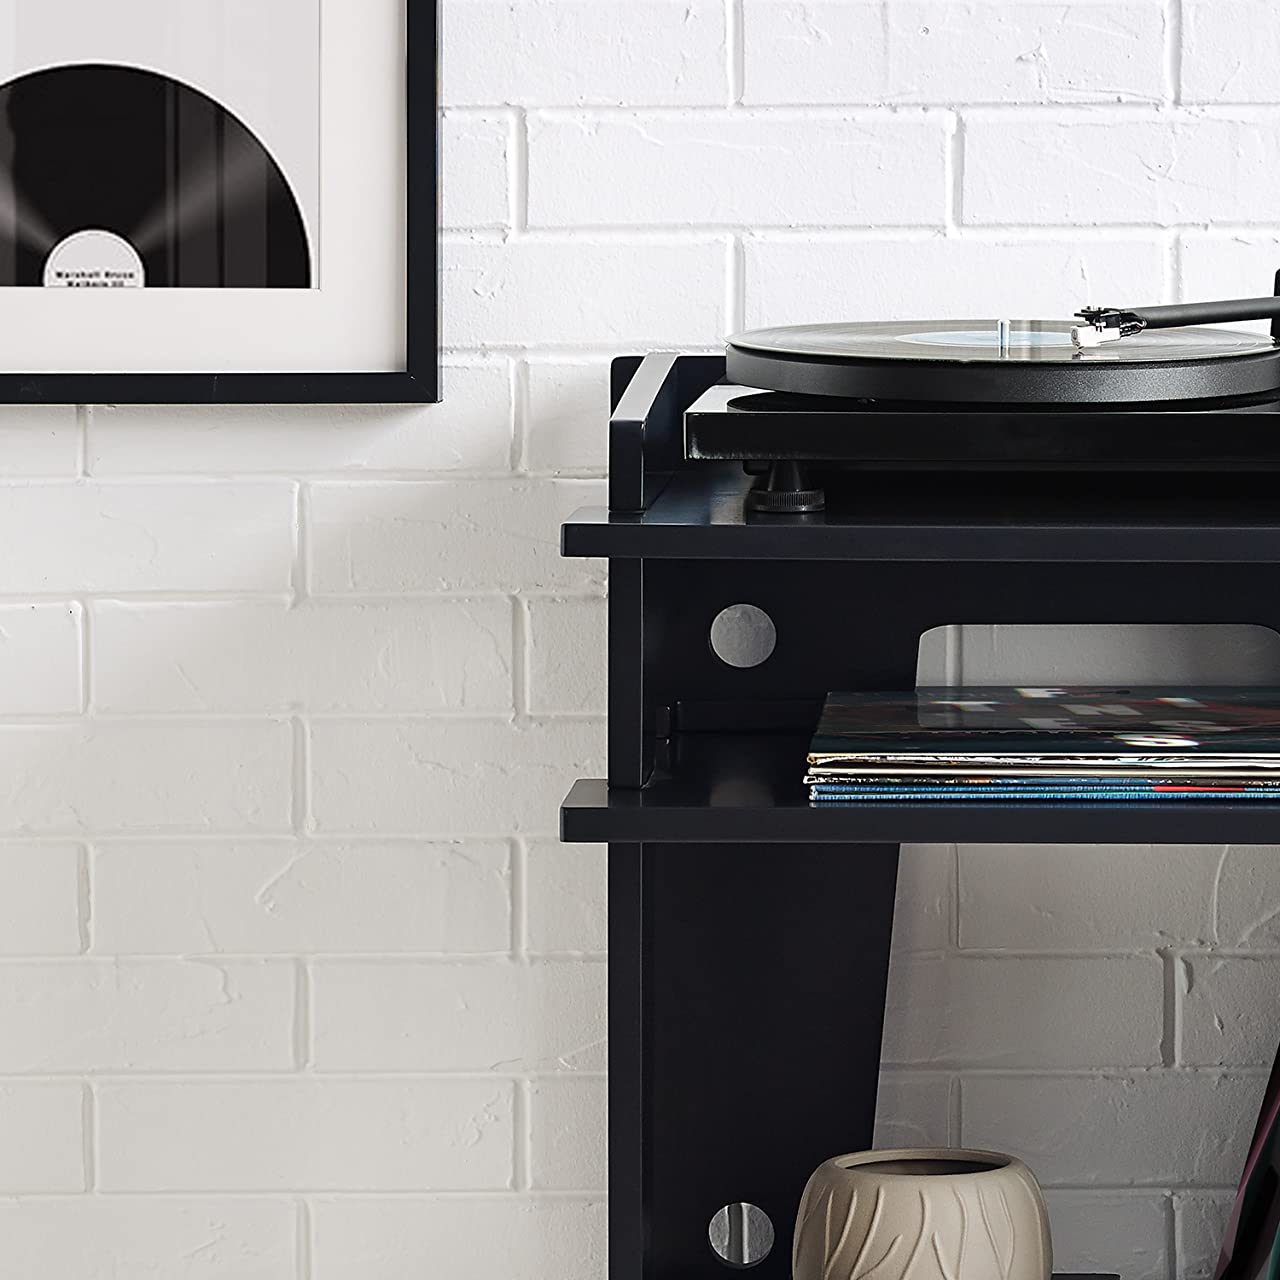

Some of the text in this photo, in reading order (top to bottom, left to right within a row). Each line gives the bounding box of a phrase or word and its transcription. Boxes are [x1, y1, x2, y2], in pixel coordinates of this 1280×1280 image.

[929, 701, 1144, 715] T N
[1018, 717, 1232, 732] E S
[1114, 733, 1200, 747] S
